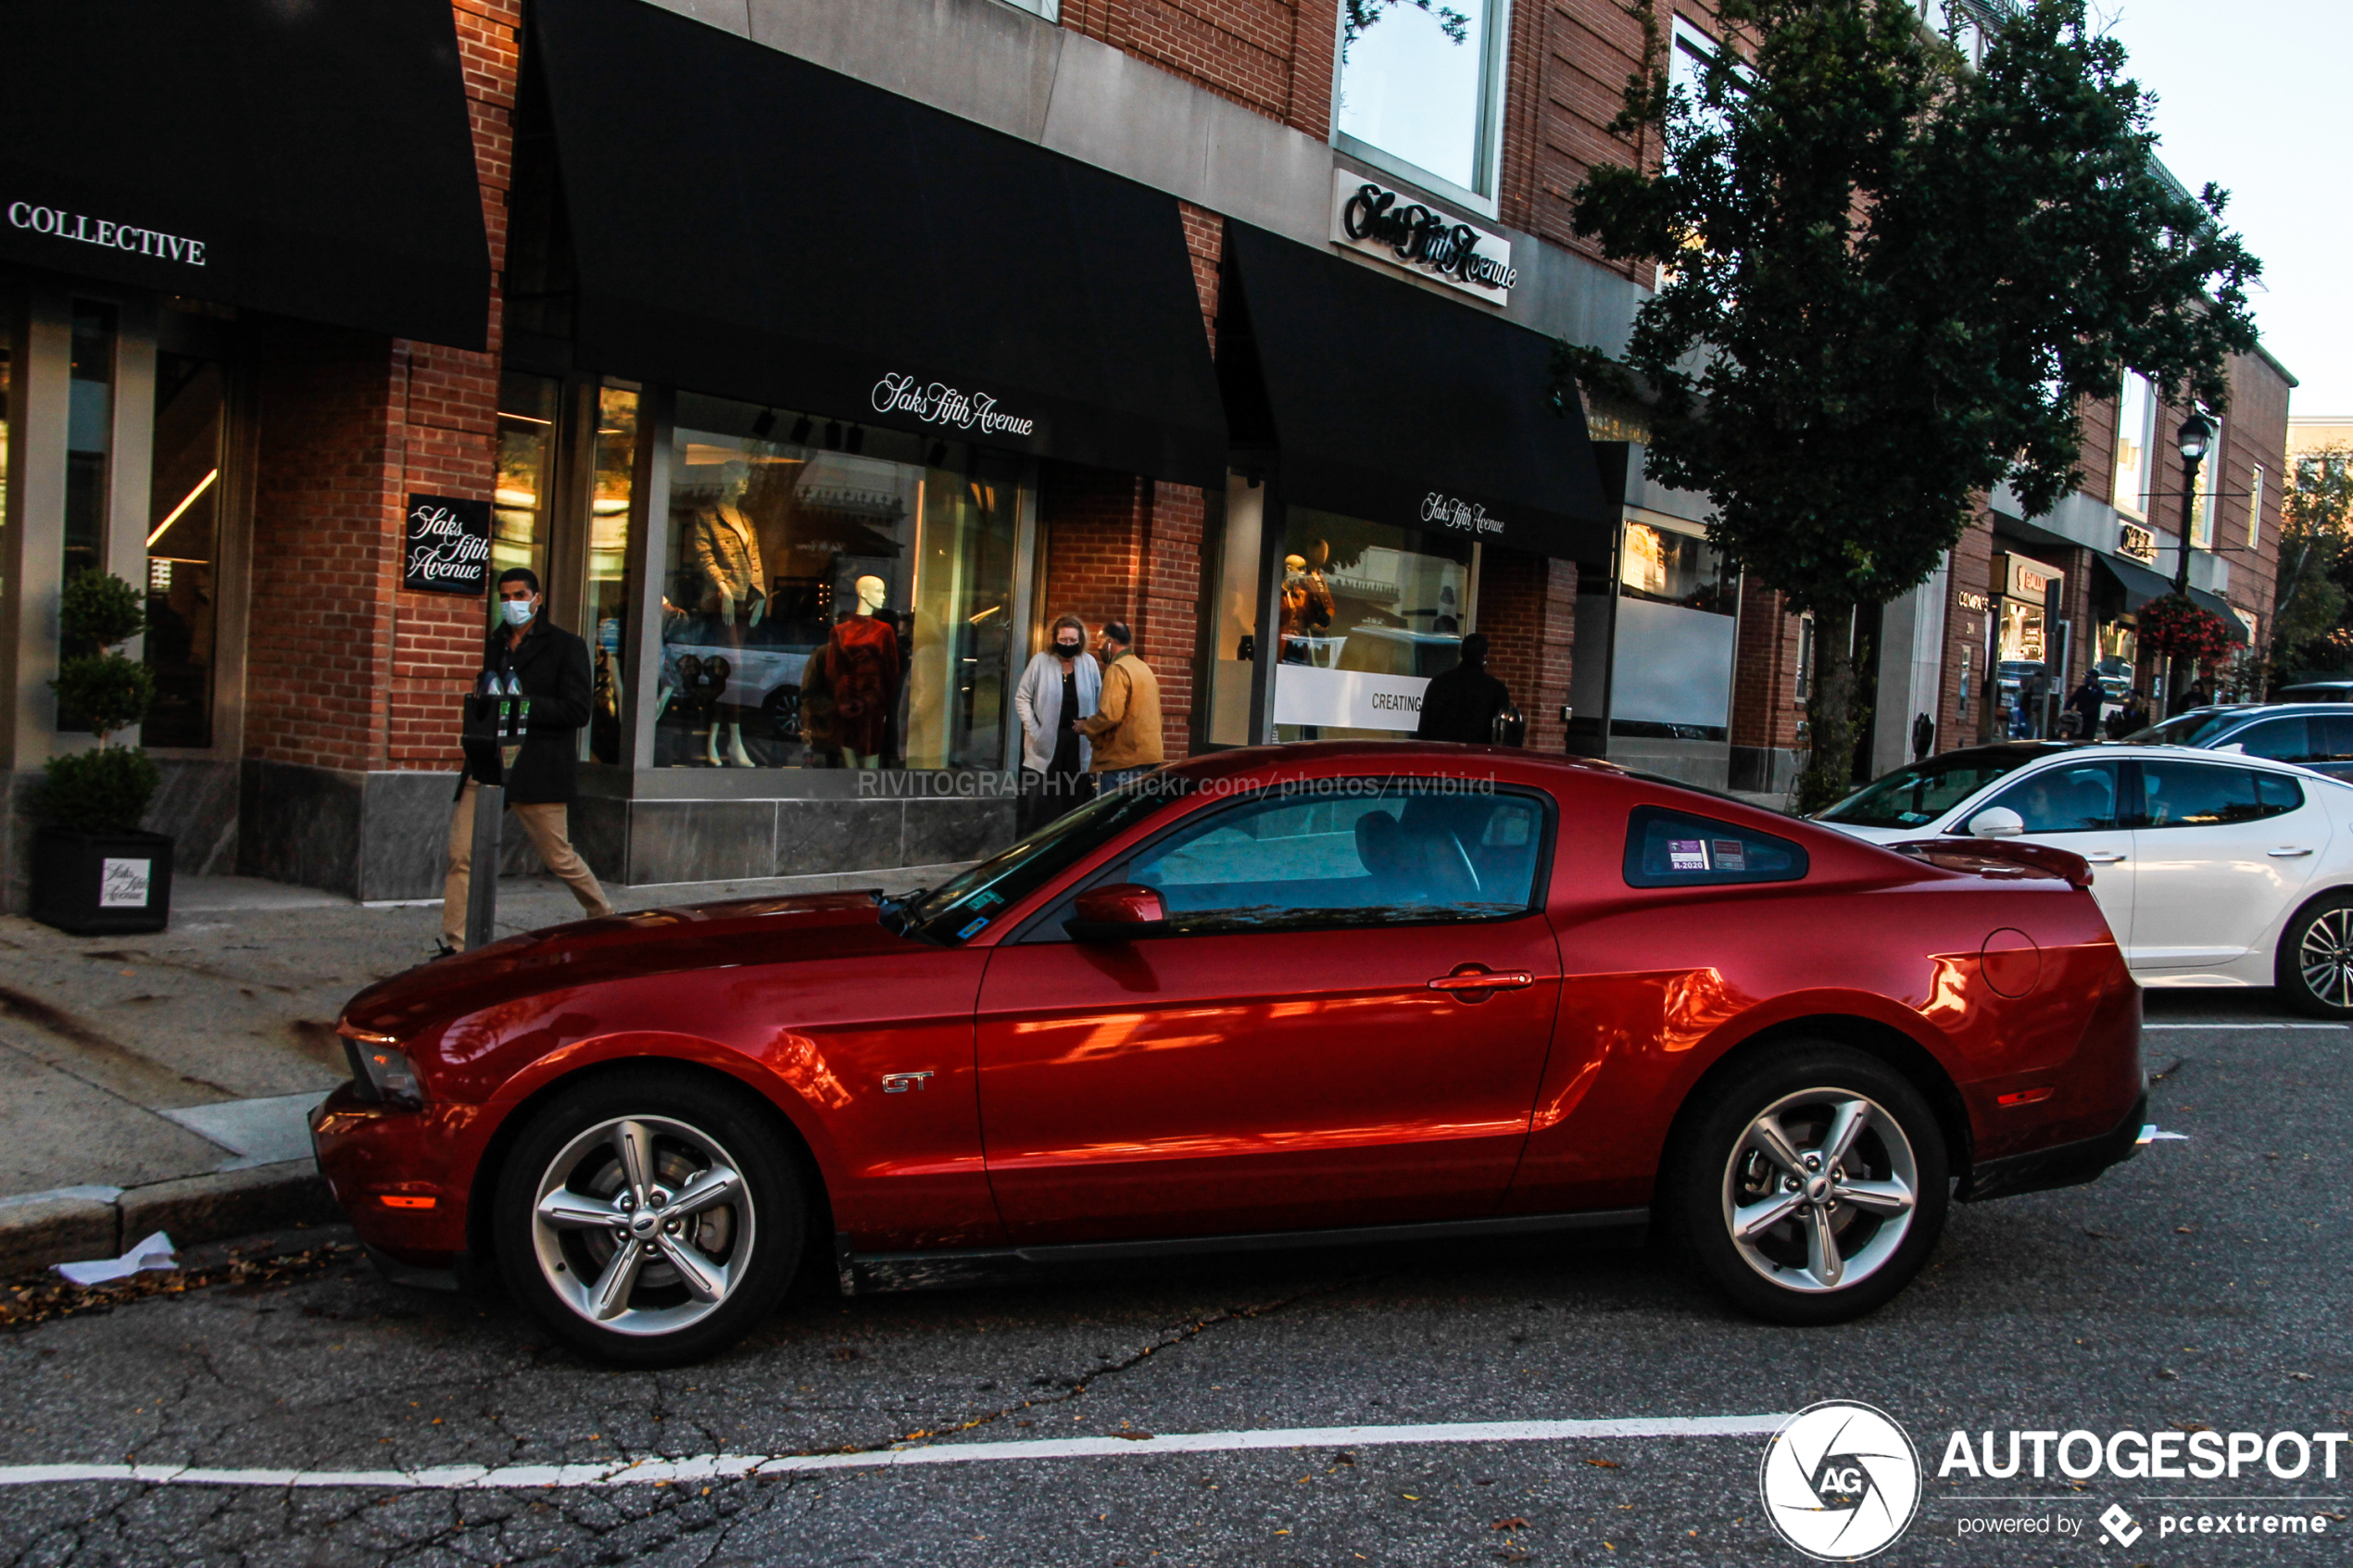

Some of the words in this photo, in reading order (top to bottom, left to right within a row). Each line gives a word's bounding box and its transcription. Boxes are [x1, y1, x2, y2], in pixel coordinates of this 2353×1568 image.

[7, 201, 206, 266] COLLECTIVE
[872, 372, 927, 413] Saks
[919, 383, 970, 425] Fifth
[957, 392, 1033, 435] Avenue
[409, 505, 463, 540] Saks
[1420, 492, 1450, 521] Saks
[1445, 498, 1471, 529] Fifth
[1465, 503, 1504, 533] Avenue
[407, 546, 481, 580] Avenue
[1372, 693, 1422, 712] CREATING
[883, 1071, 934, 1093] GT
